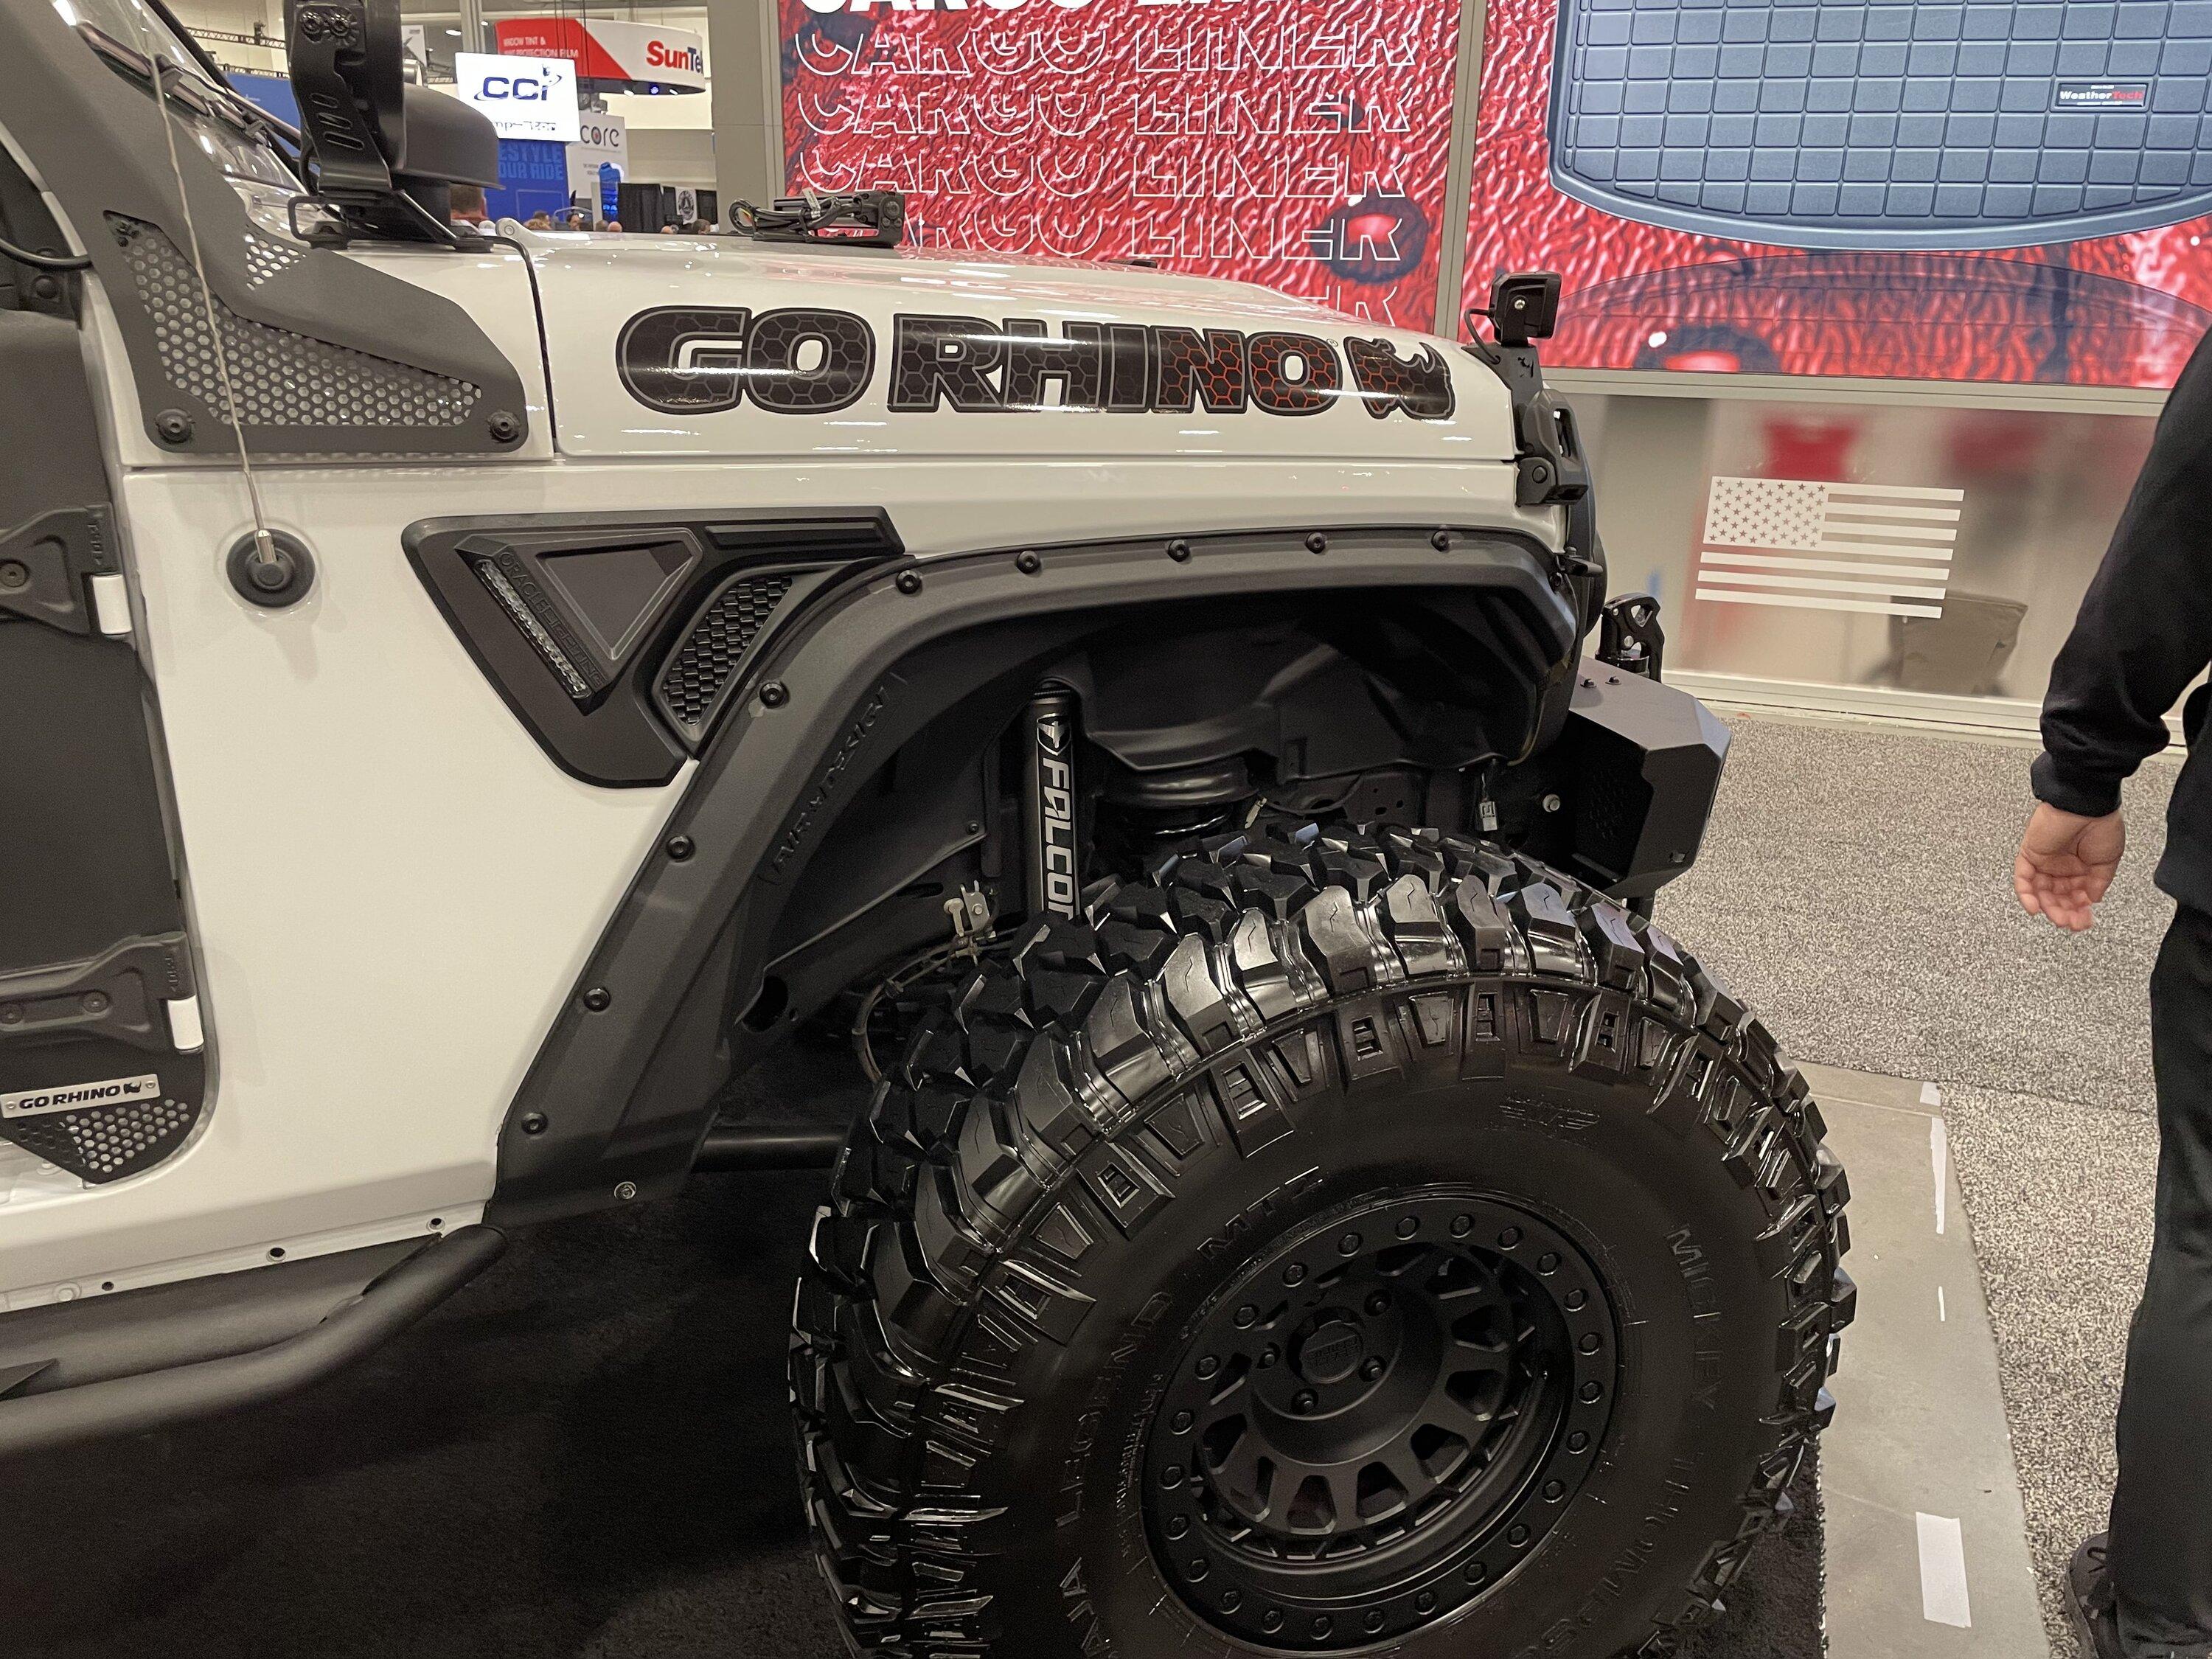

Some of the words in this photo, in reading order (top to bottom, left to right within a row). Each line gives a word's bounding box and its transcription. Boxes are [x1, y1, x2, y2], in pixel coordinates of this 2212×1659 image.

[560, 49, 580, 58] FILM
[499, 142, 563, 163] ESTYLE
[616, 306, 875, 414] GO
[887, 313, 1343, 416] RHINO
[19, 1096, 50, 1109] GO
[52, 1085, 120, 1105] RHINO
